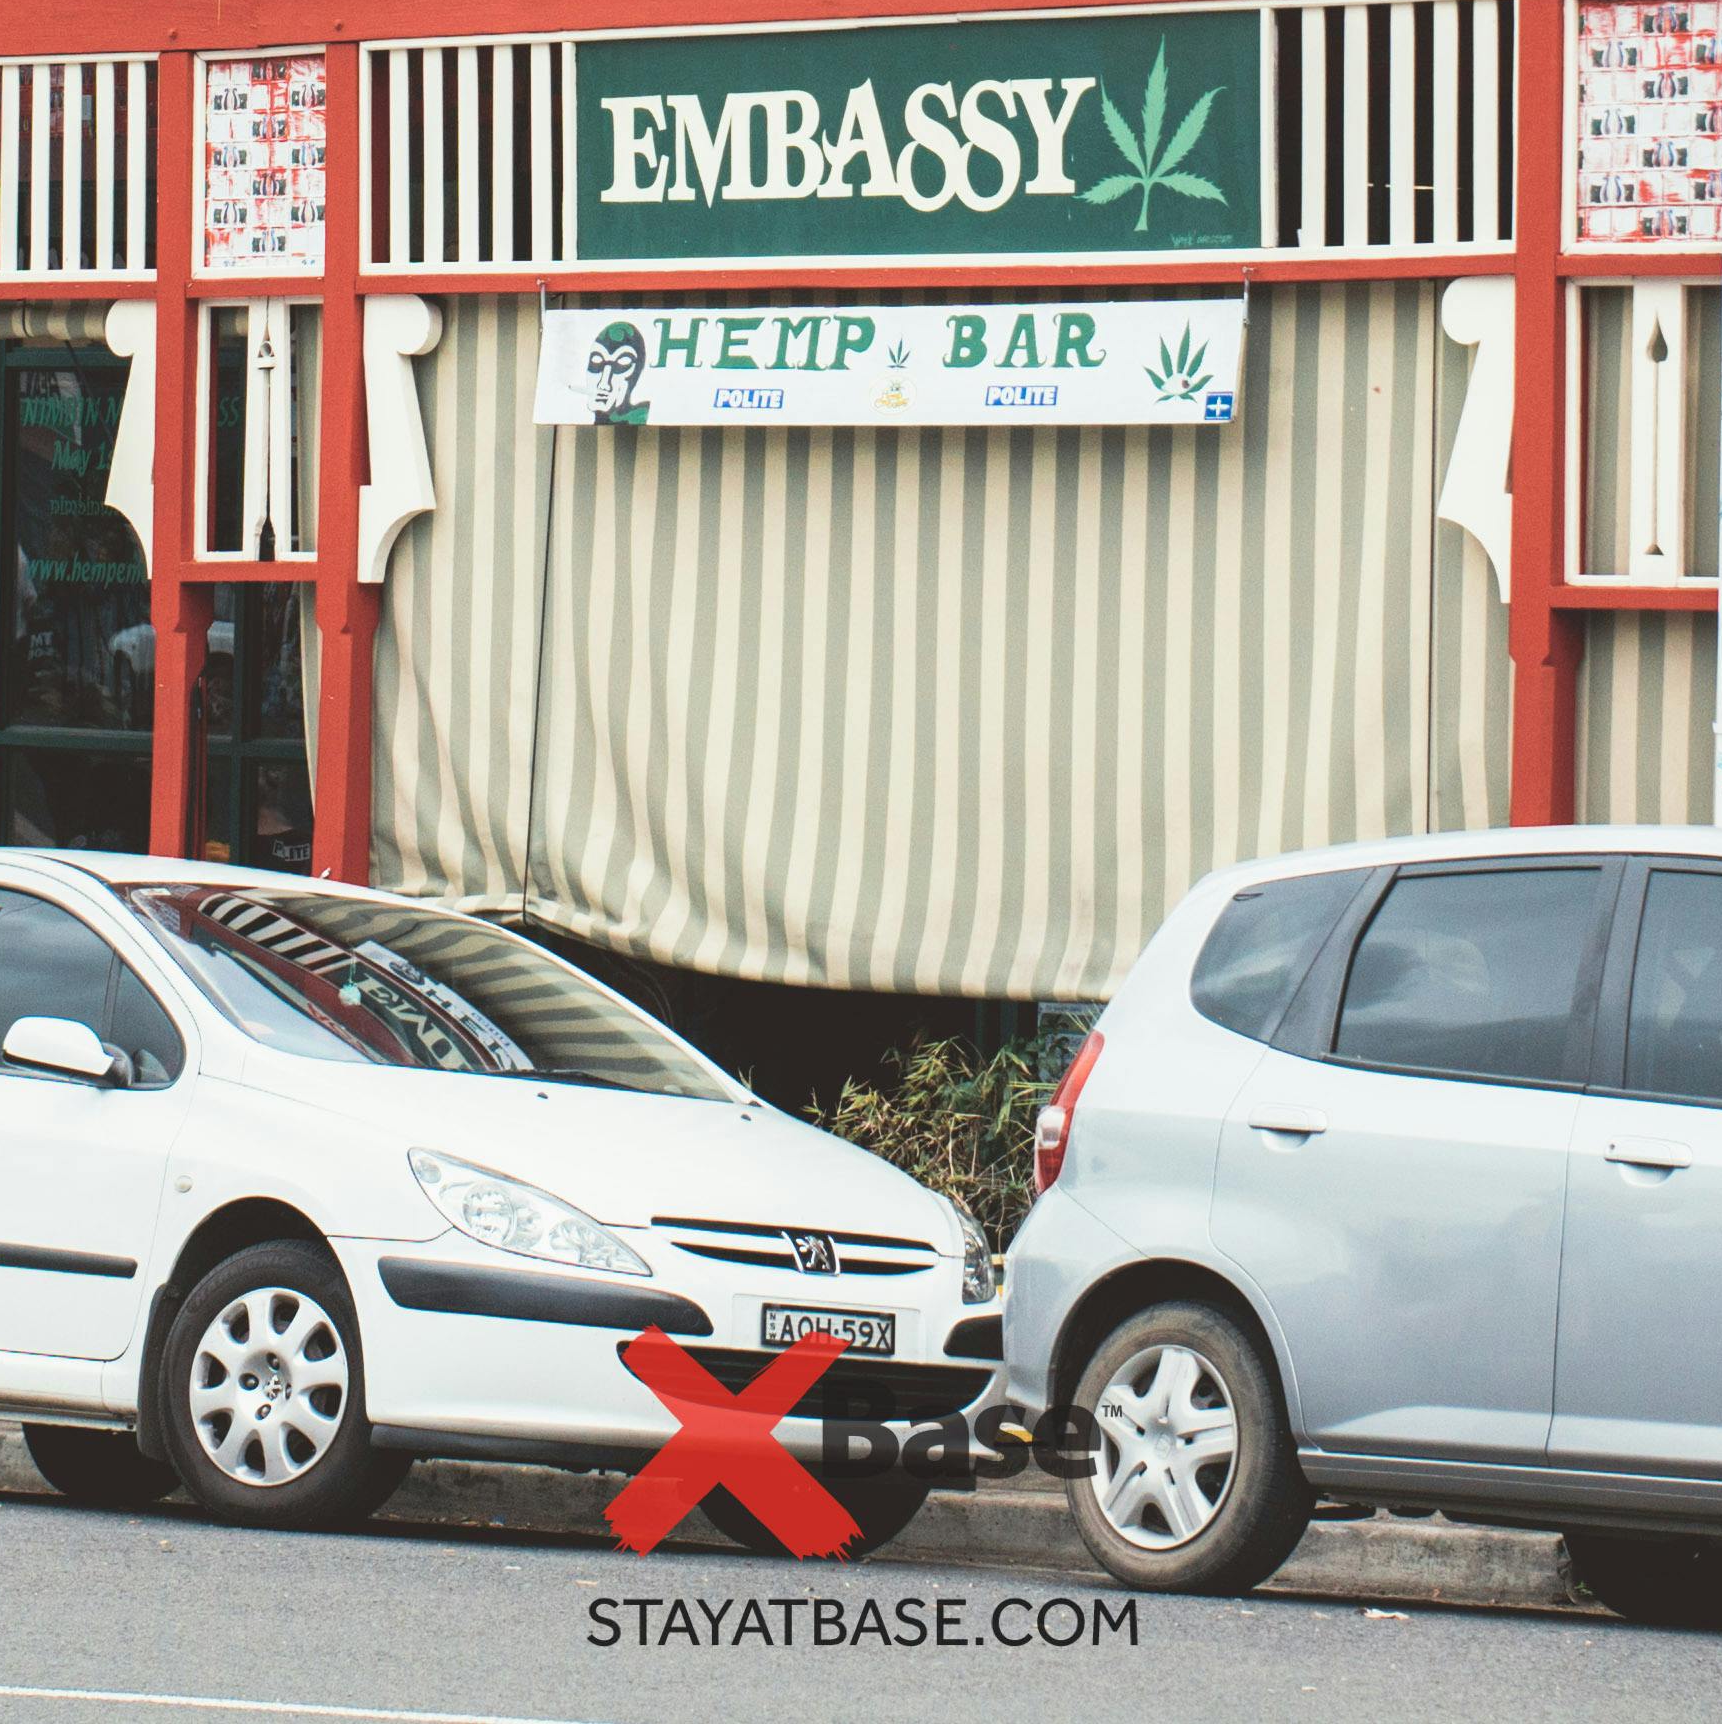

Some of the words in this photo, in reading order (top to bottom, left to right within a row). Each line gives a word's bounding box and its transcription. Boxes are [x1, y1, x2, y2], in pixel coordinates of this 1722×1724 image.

[600, 75, 1097, 214] EMBASSY
[648, 315, 876, 370] HEMP
[941, 312, 1107, 368] BAR
[715, 388, 784, 409] POLITE
[986, 386, 1057, 406] POLITE
